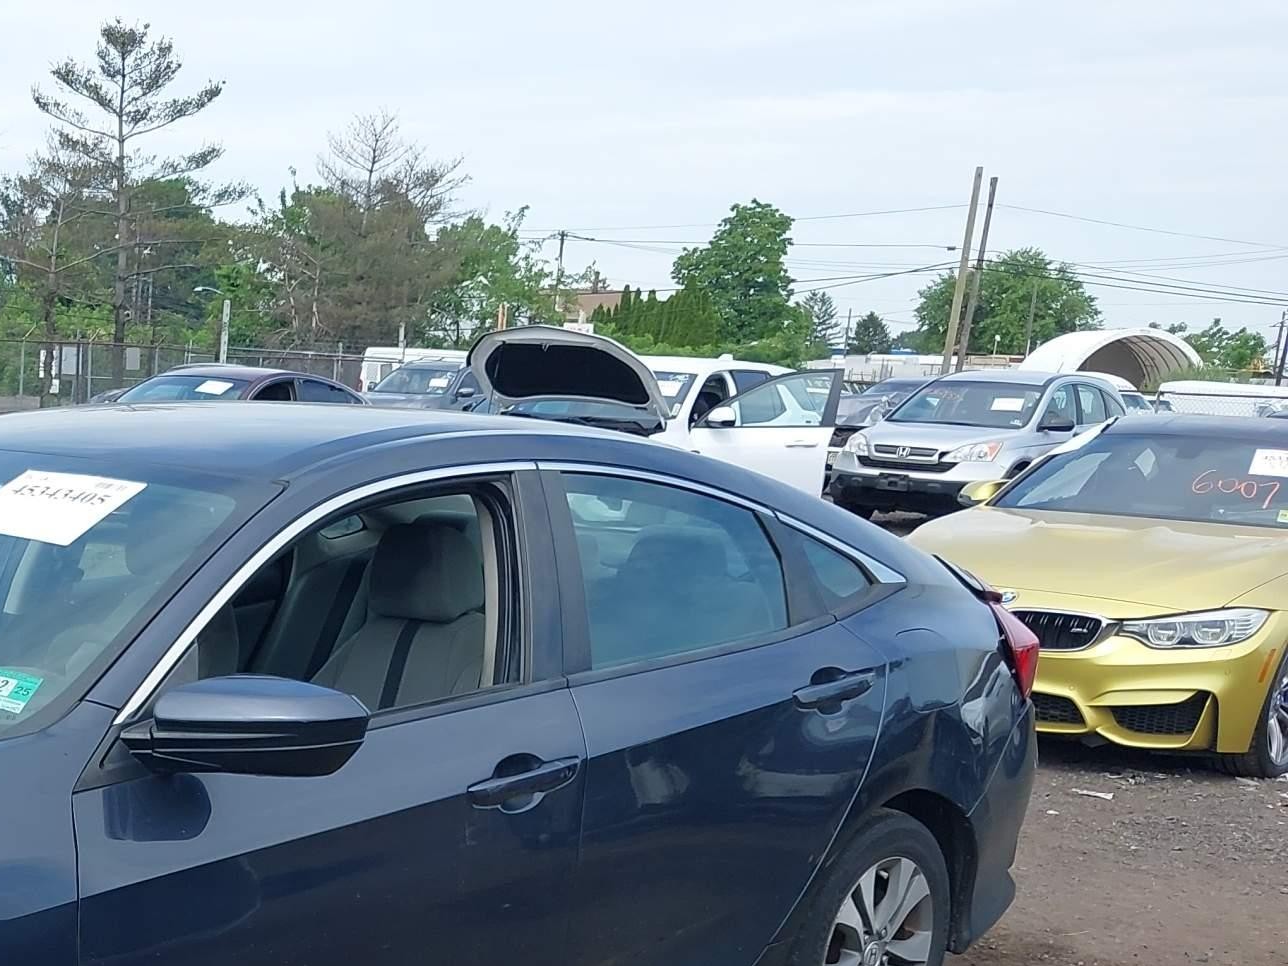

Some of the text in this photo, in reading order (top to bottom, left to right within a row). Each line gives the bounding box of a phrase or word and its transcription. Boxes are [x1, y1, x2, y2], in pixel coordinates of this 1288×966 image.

[12, 484, 112, 505] 45343405
[1191, 468, 1280, 510] 6007
[14, 685, 32, 697] 25
